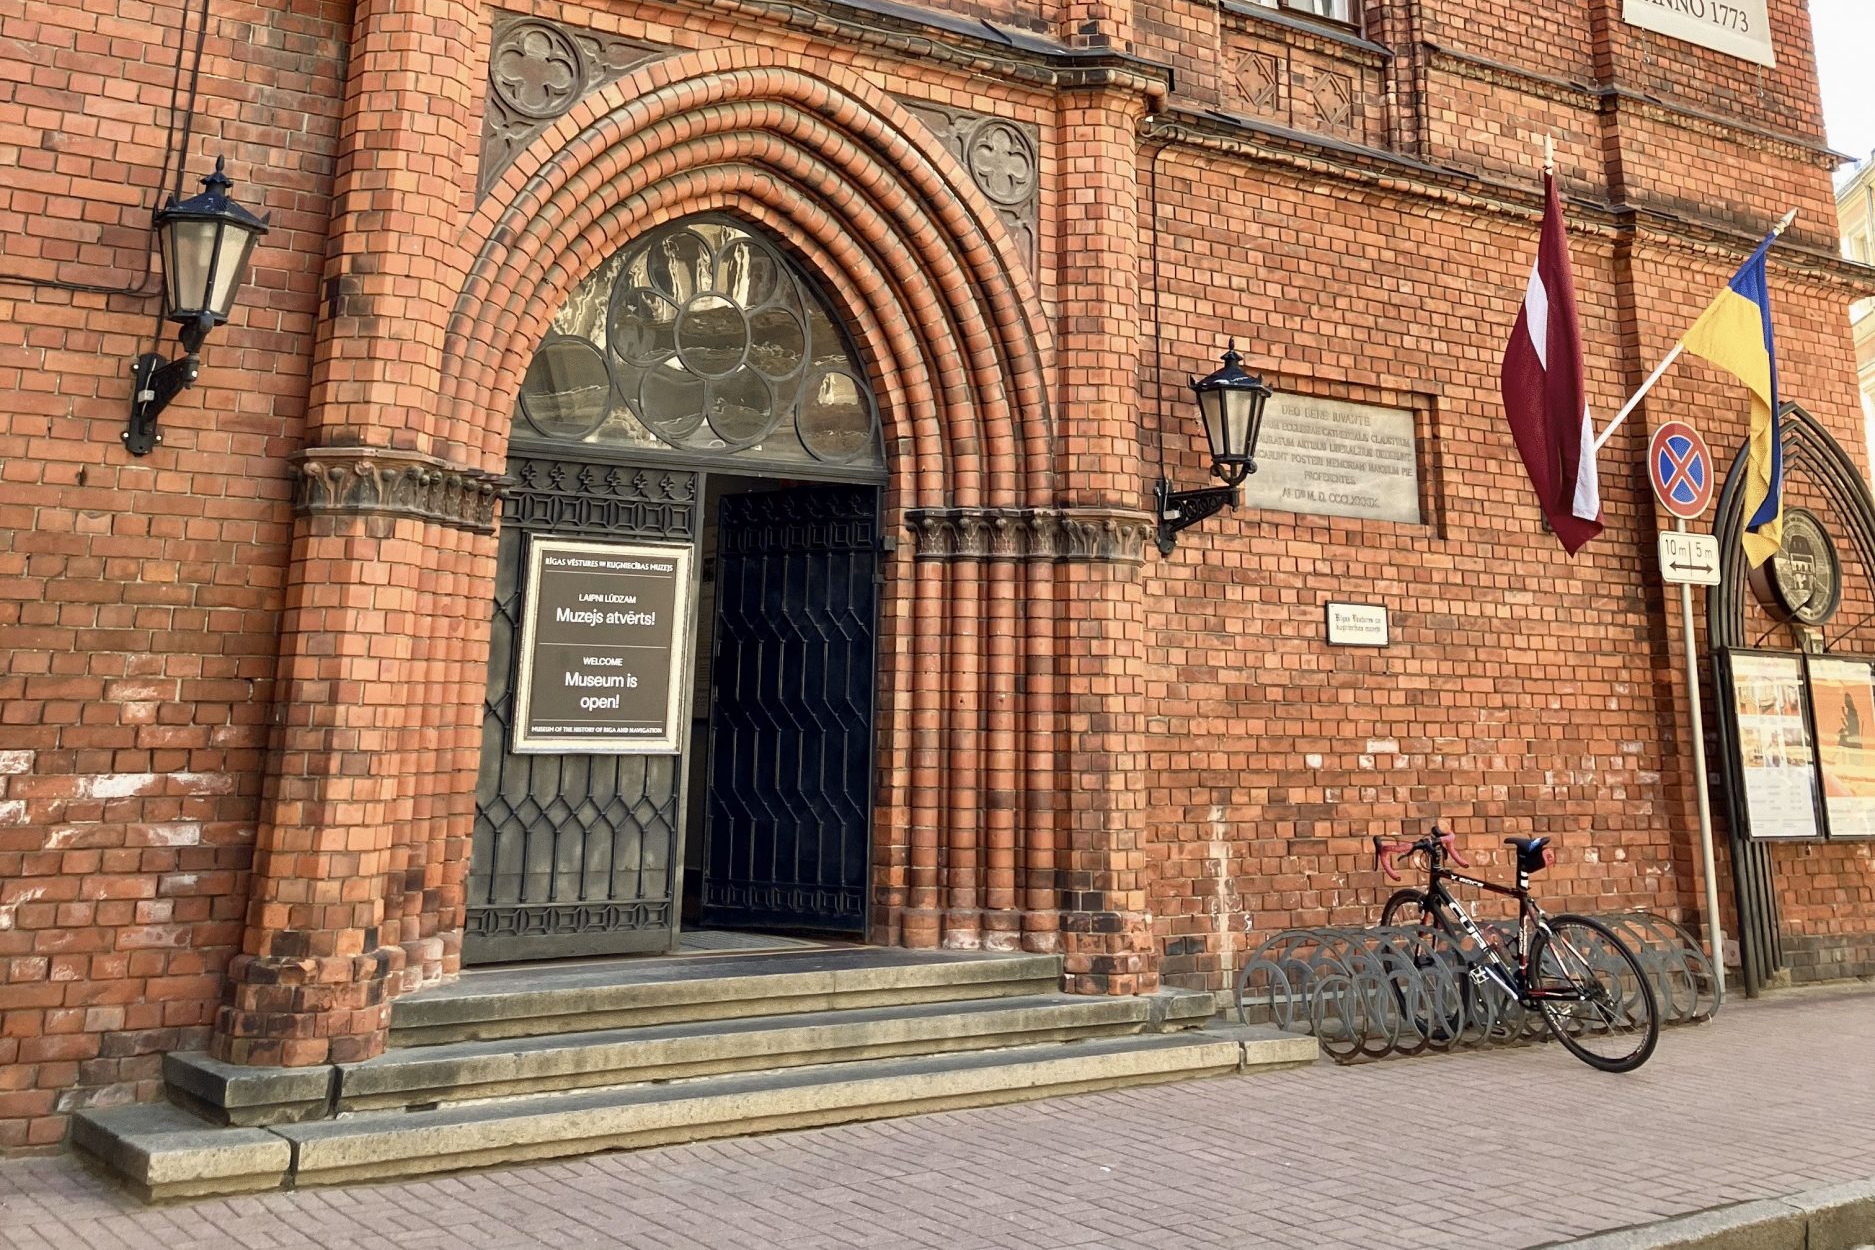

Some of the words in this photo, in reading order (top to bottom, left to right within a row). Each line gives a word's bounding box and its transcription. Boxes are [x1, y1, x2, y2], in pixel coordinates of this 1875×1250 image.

[1711, 1, 1749, 33] 1773
[1665, 539, 1676, 555] 10
[1679, 547, 1686, 556] m
[1696, 542, 1702, 557] 5
[1705, 549, 1712, 558] m
[650, 564, 673, 573] MUZEJS
[579, 593, 604, 602] LAIPNI
[604, 593, 637, 604] LŪDZAM
[556, 607, 604, 626] Muzejs
[606, 611, 656, 625] atvērts!
[583, 656, 623, 666] WELCOME
[565, 671, 624, 687] Museum
[626, 673, 638, 688] is
[580, 694, 620, 711] open!
